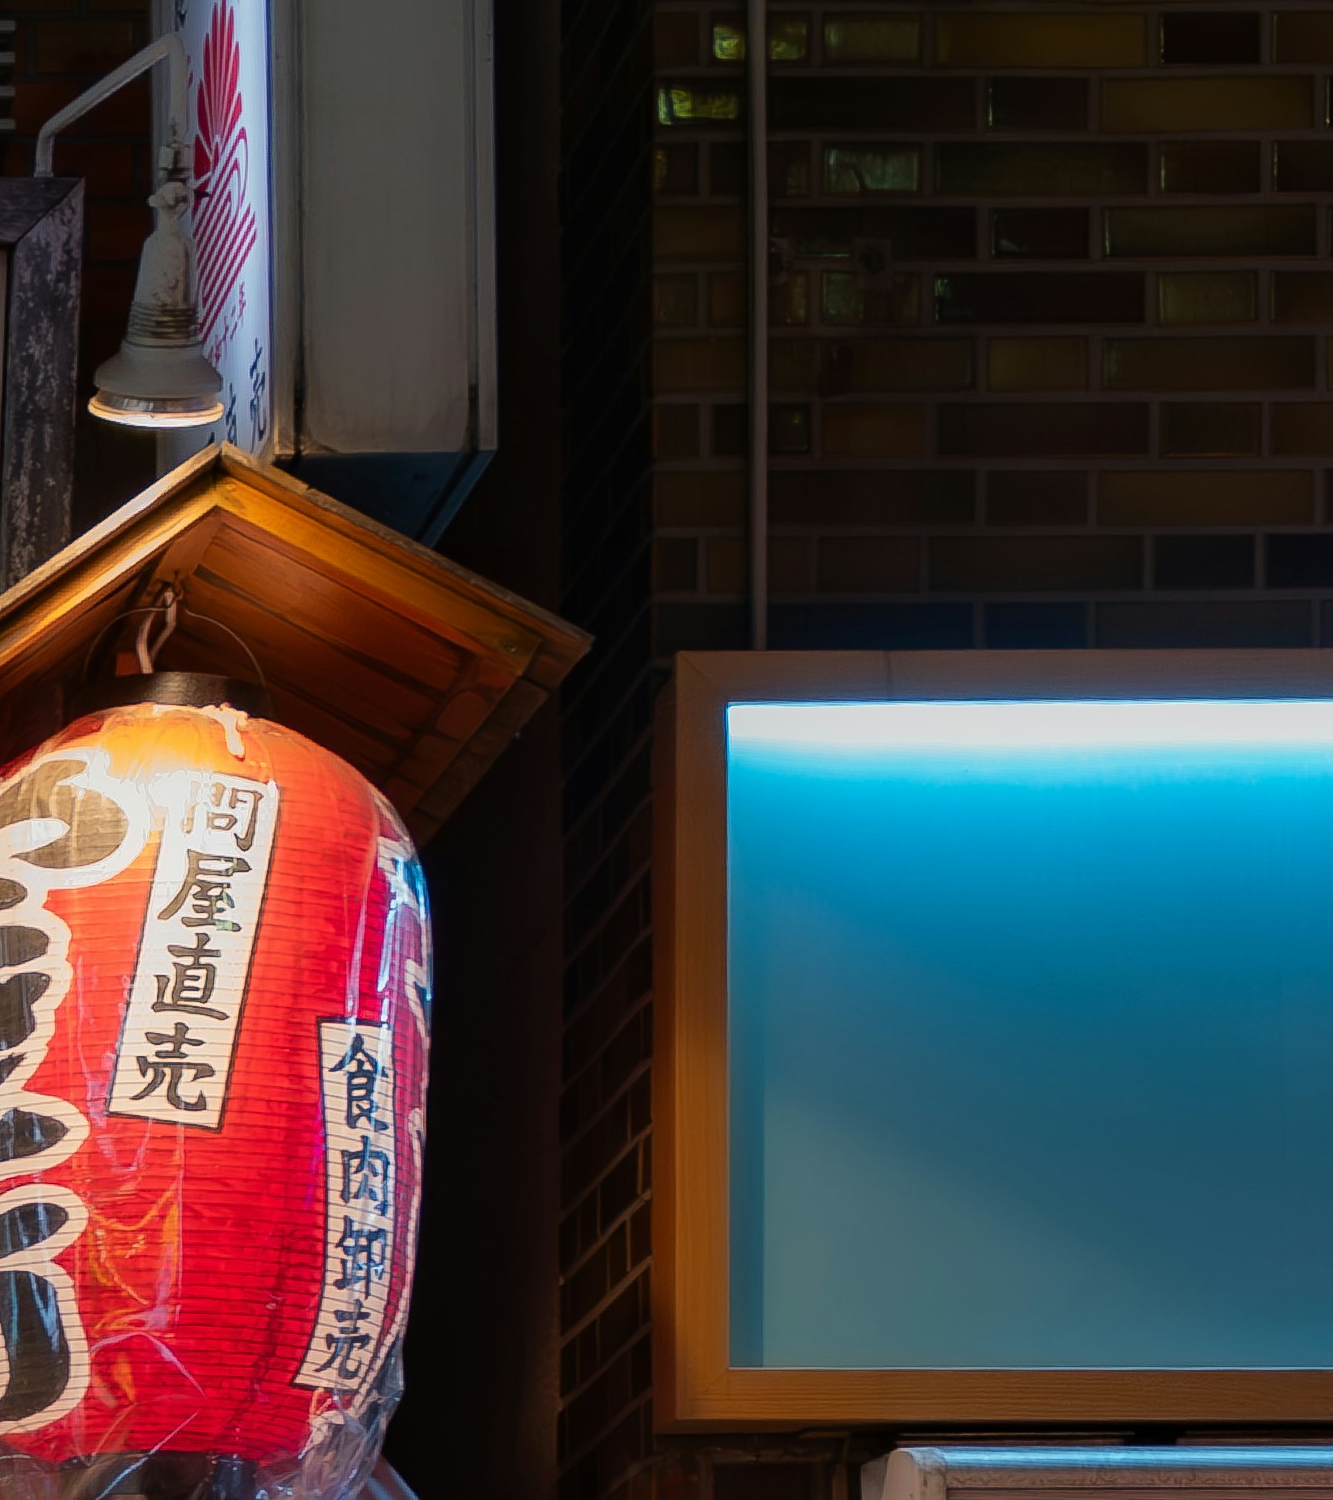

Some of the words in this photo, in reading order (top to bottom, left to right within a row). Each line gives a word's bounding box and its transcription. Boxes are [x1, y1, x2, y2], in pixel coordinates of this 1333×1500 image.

[126, 777, 265, 1114] 問屋直売
[311, 1031, 393, 1384] 食肉卸売
